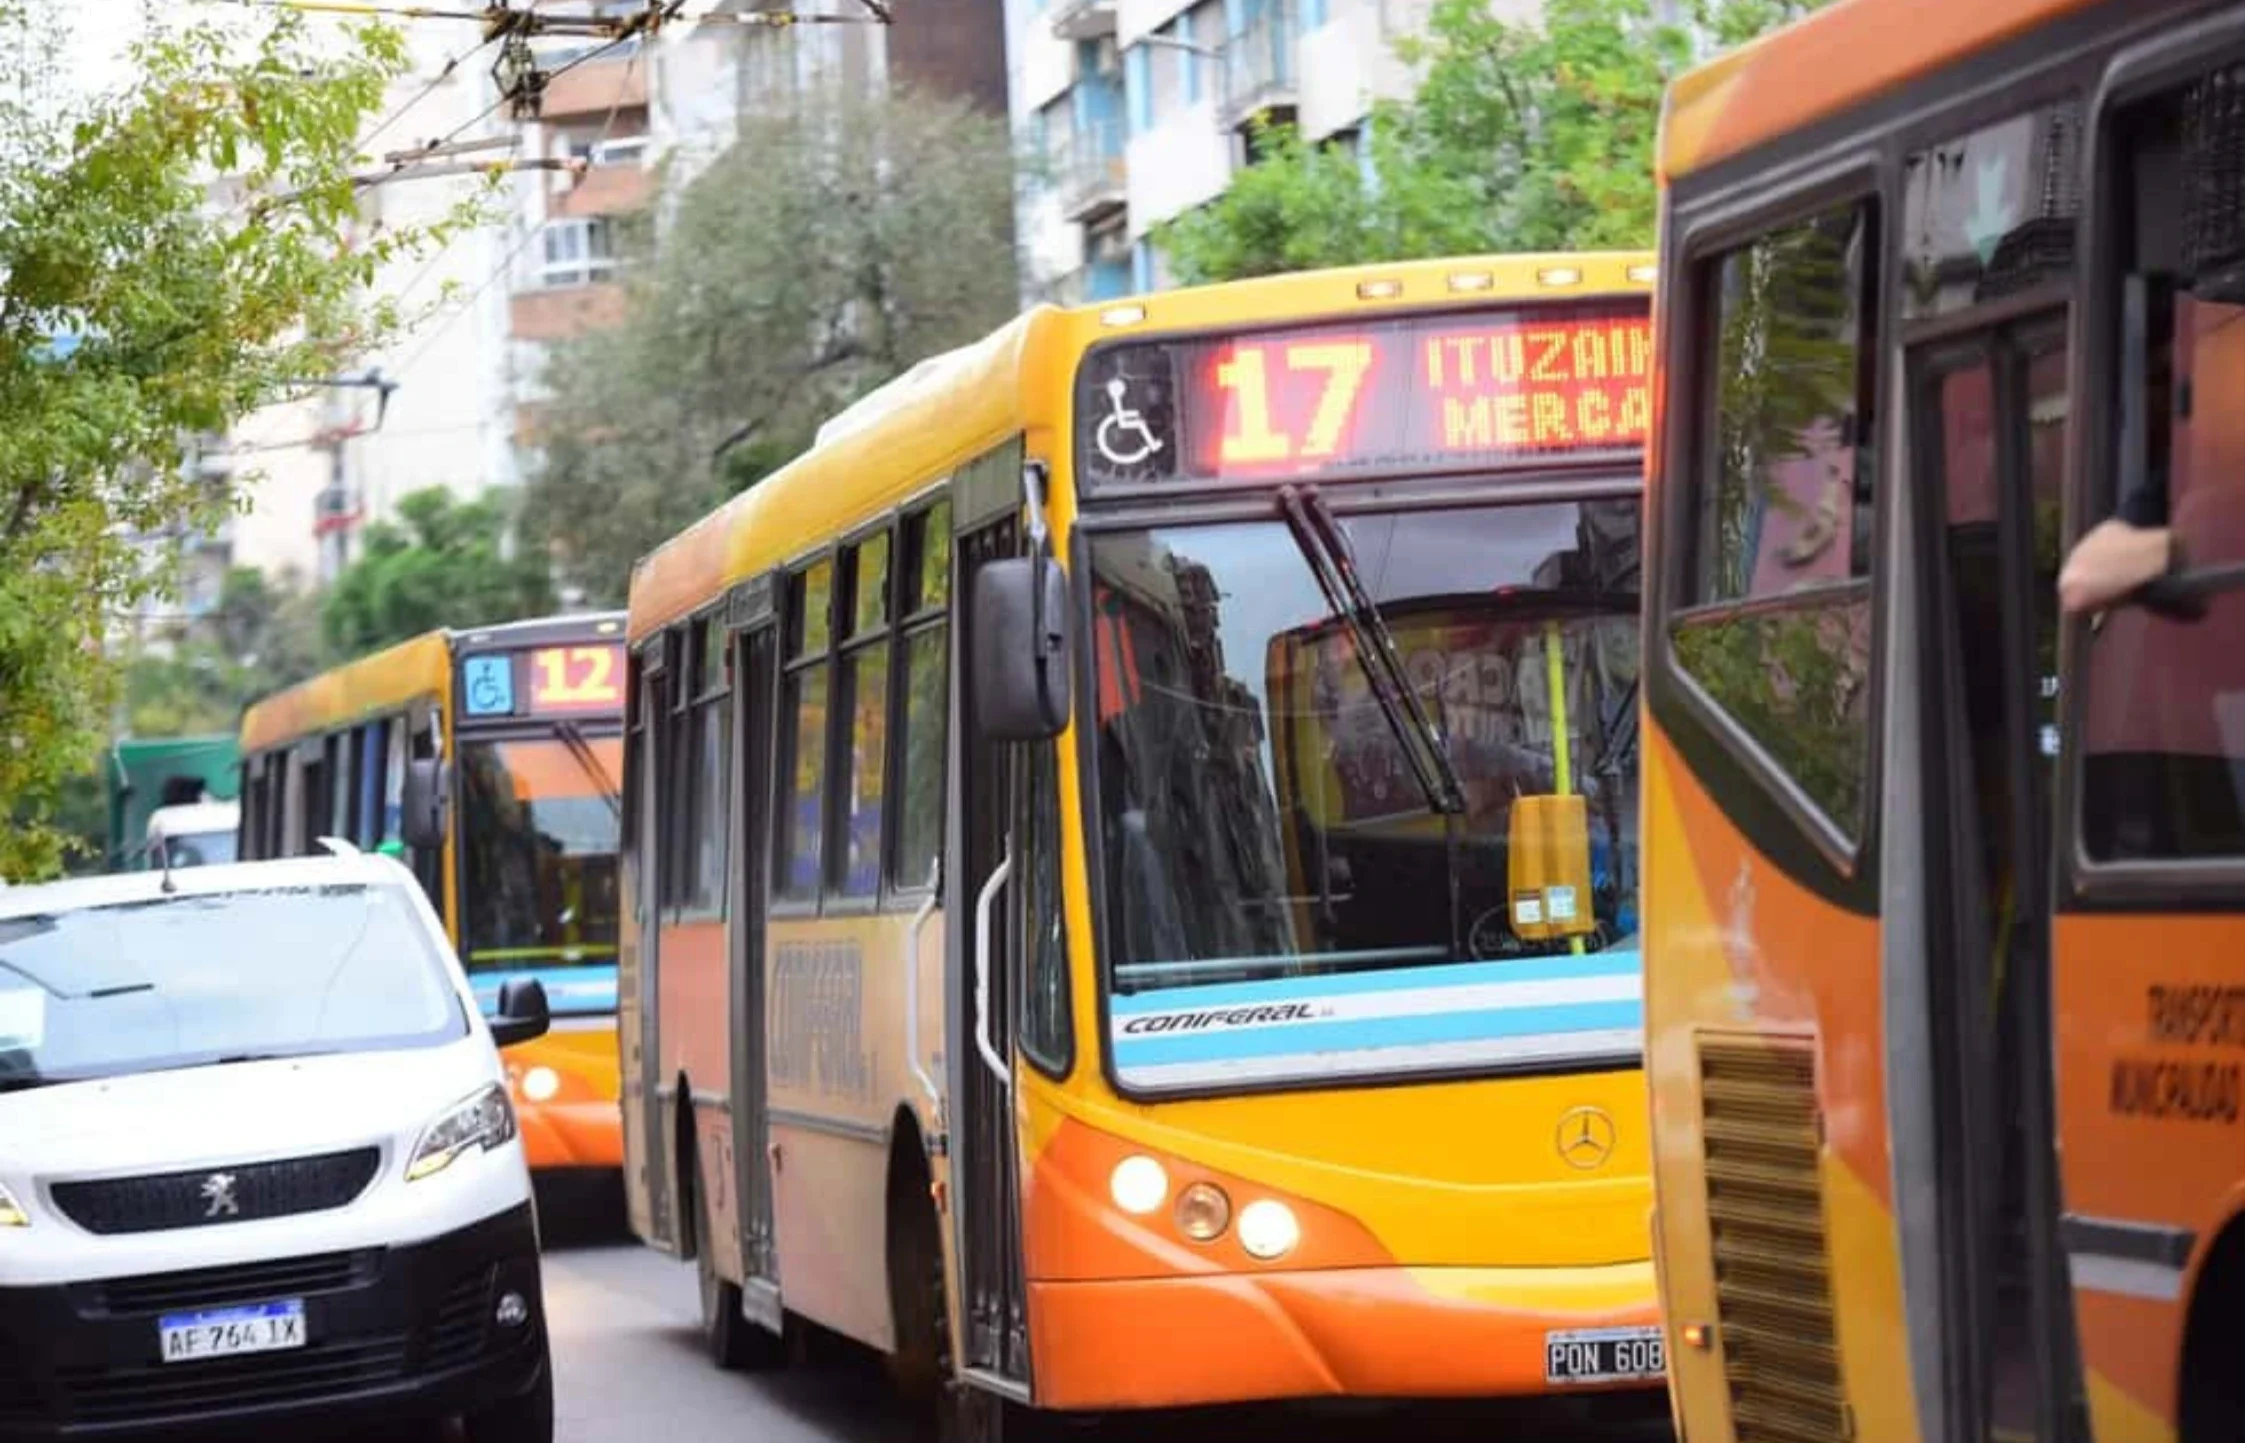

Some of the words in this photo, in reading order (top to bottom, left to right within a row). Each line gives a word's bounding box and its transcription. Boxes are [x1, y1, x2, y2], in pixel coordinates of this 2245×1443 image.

[1217, 342, 1373, 462] 17
[536, 647, 618, 702] 12
[1550, 1342, 1600, 1374] PON
[1614, 1340, 1664, 1372] 608
